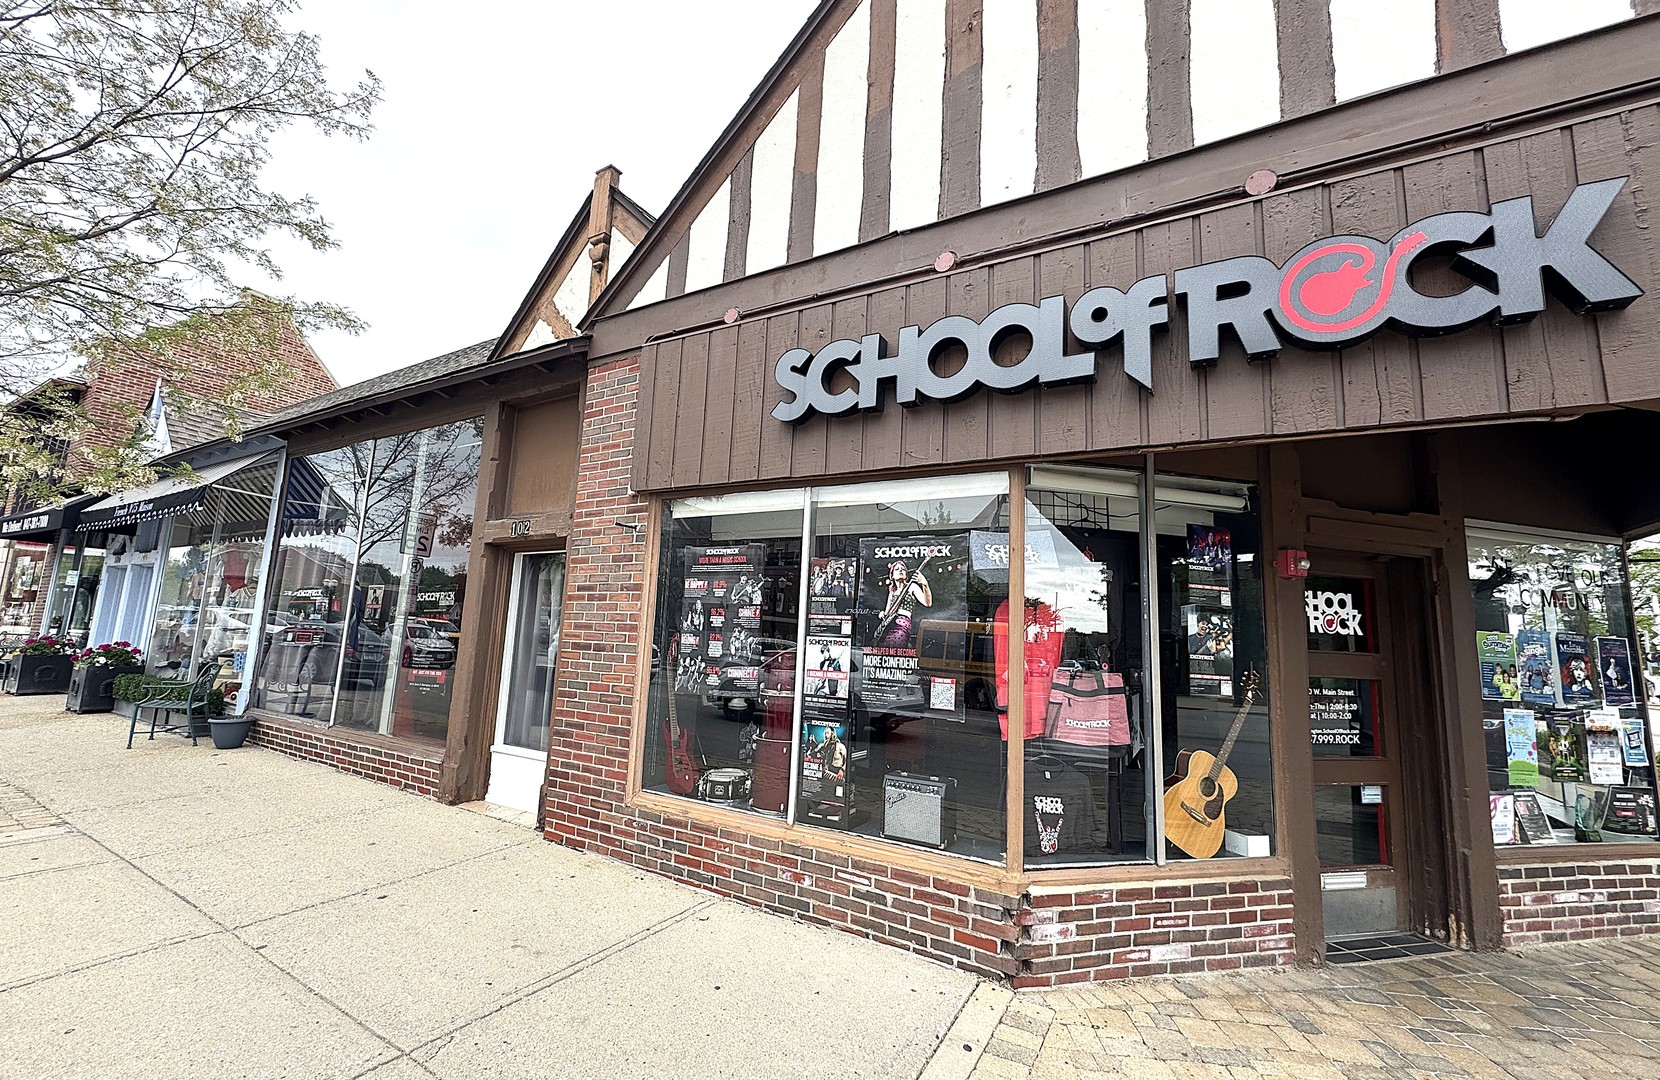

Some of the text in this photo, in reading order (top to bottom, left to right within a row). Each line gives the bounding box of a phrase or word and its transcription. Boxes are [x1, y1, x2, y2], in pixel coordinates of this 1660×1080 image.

[770, 295, 1096, 426] SCHOOL
[1174, 176, 1644, 368] ROCK
[511, 520, 530, 536] 102
[874, 546, 911, 559] SCHOOL
[919, 545, 952, 557] ROCK
[1309, 612, 1364, 636] ROCK
[863, 655, 920, 669] MORE CONFIDENT.
[1322, 688, 1337, 696] Main
[1034, 796, 1062, 807] SCHOOL
